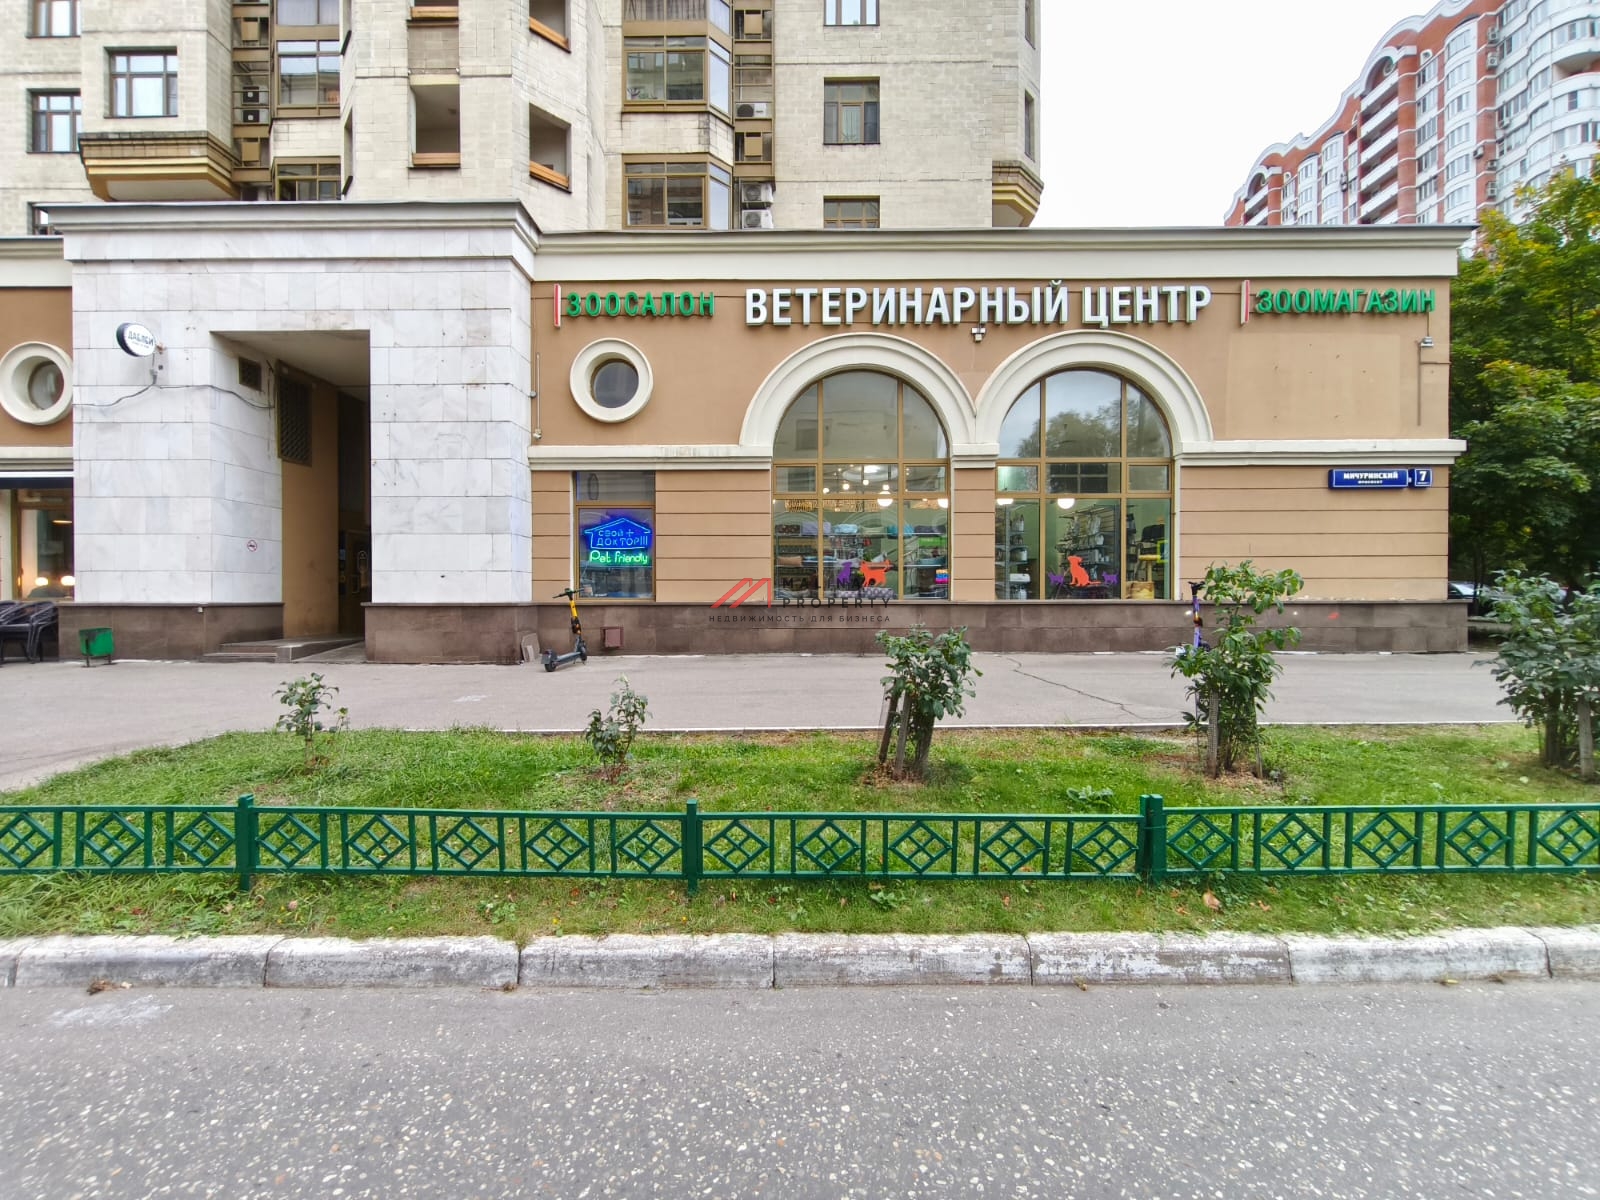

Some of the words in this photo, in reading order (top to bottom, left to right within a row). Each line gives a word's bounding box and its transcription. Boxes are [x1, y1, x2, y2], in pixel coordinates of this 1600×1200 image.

[566, 291, 715, 317] ЗООСАЛОН
[745, 279, 1068, 326] ВЕТЕРИНАРНЫЙ
[1081, 285, 1212, 327] ЦЕНТР
[1256, 288, 1436, 314] ЗООМАГАЗИН
[1343, 471, 1399, 480] МИЧУРИНСКИЙ
[1419, 470, 1427, 482] 7
[589, 549, 612, 563] Pet
[614, 550, 649, 565] friendly
